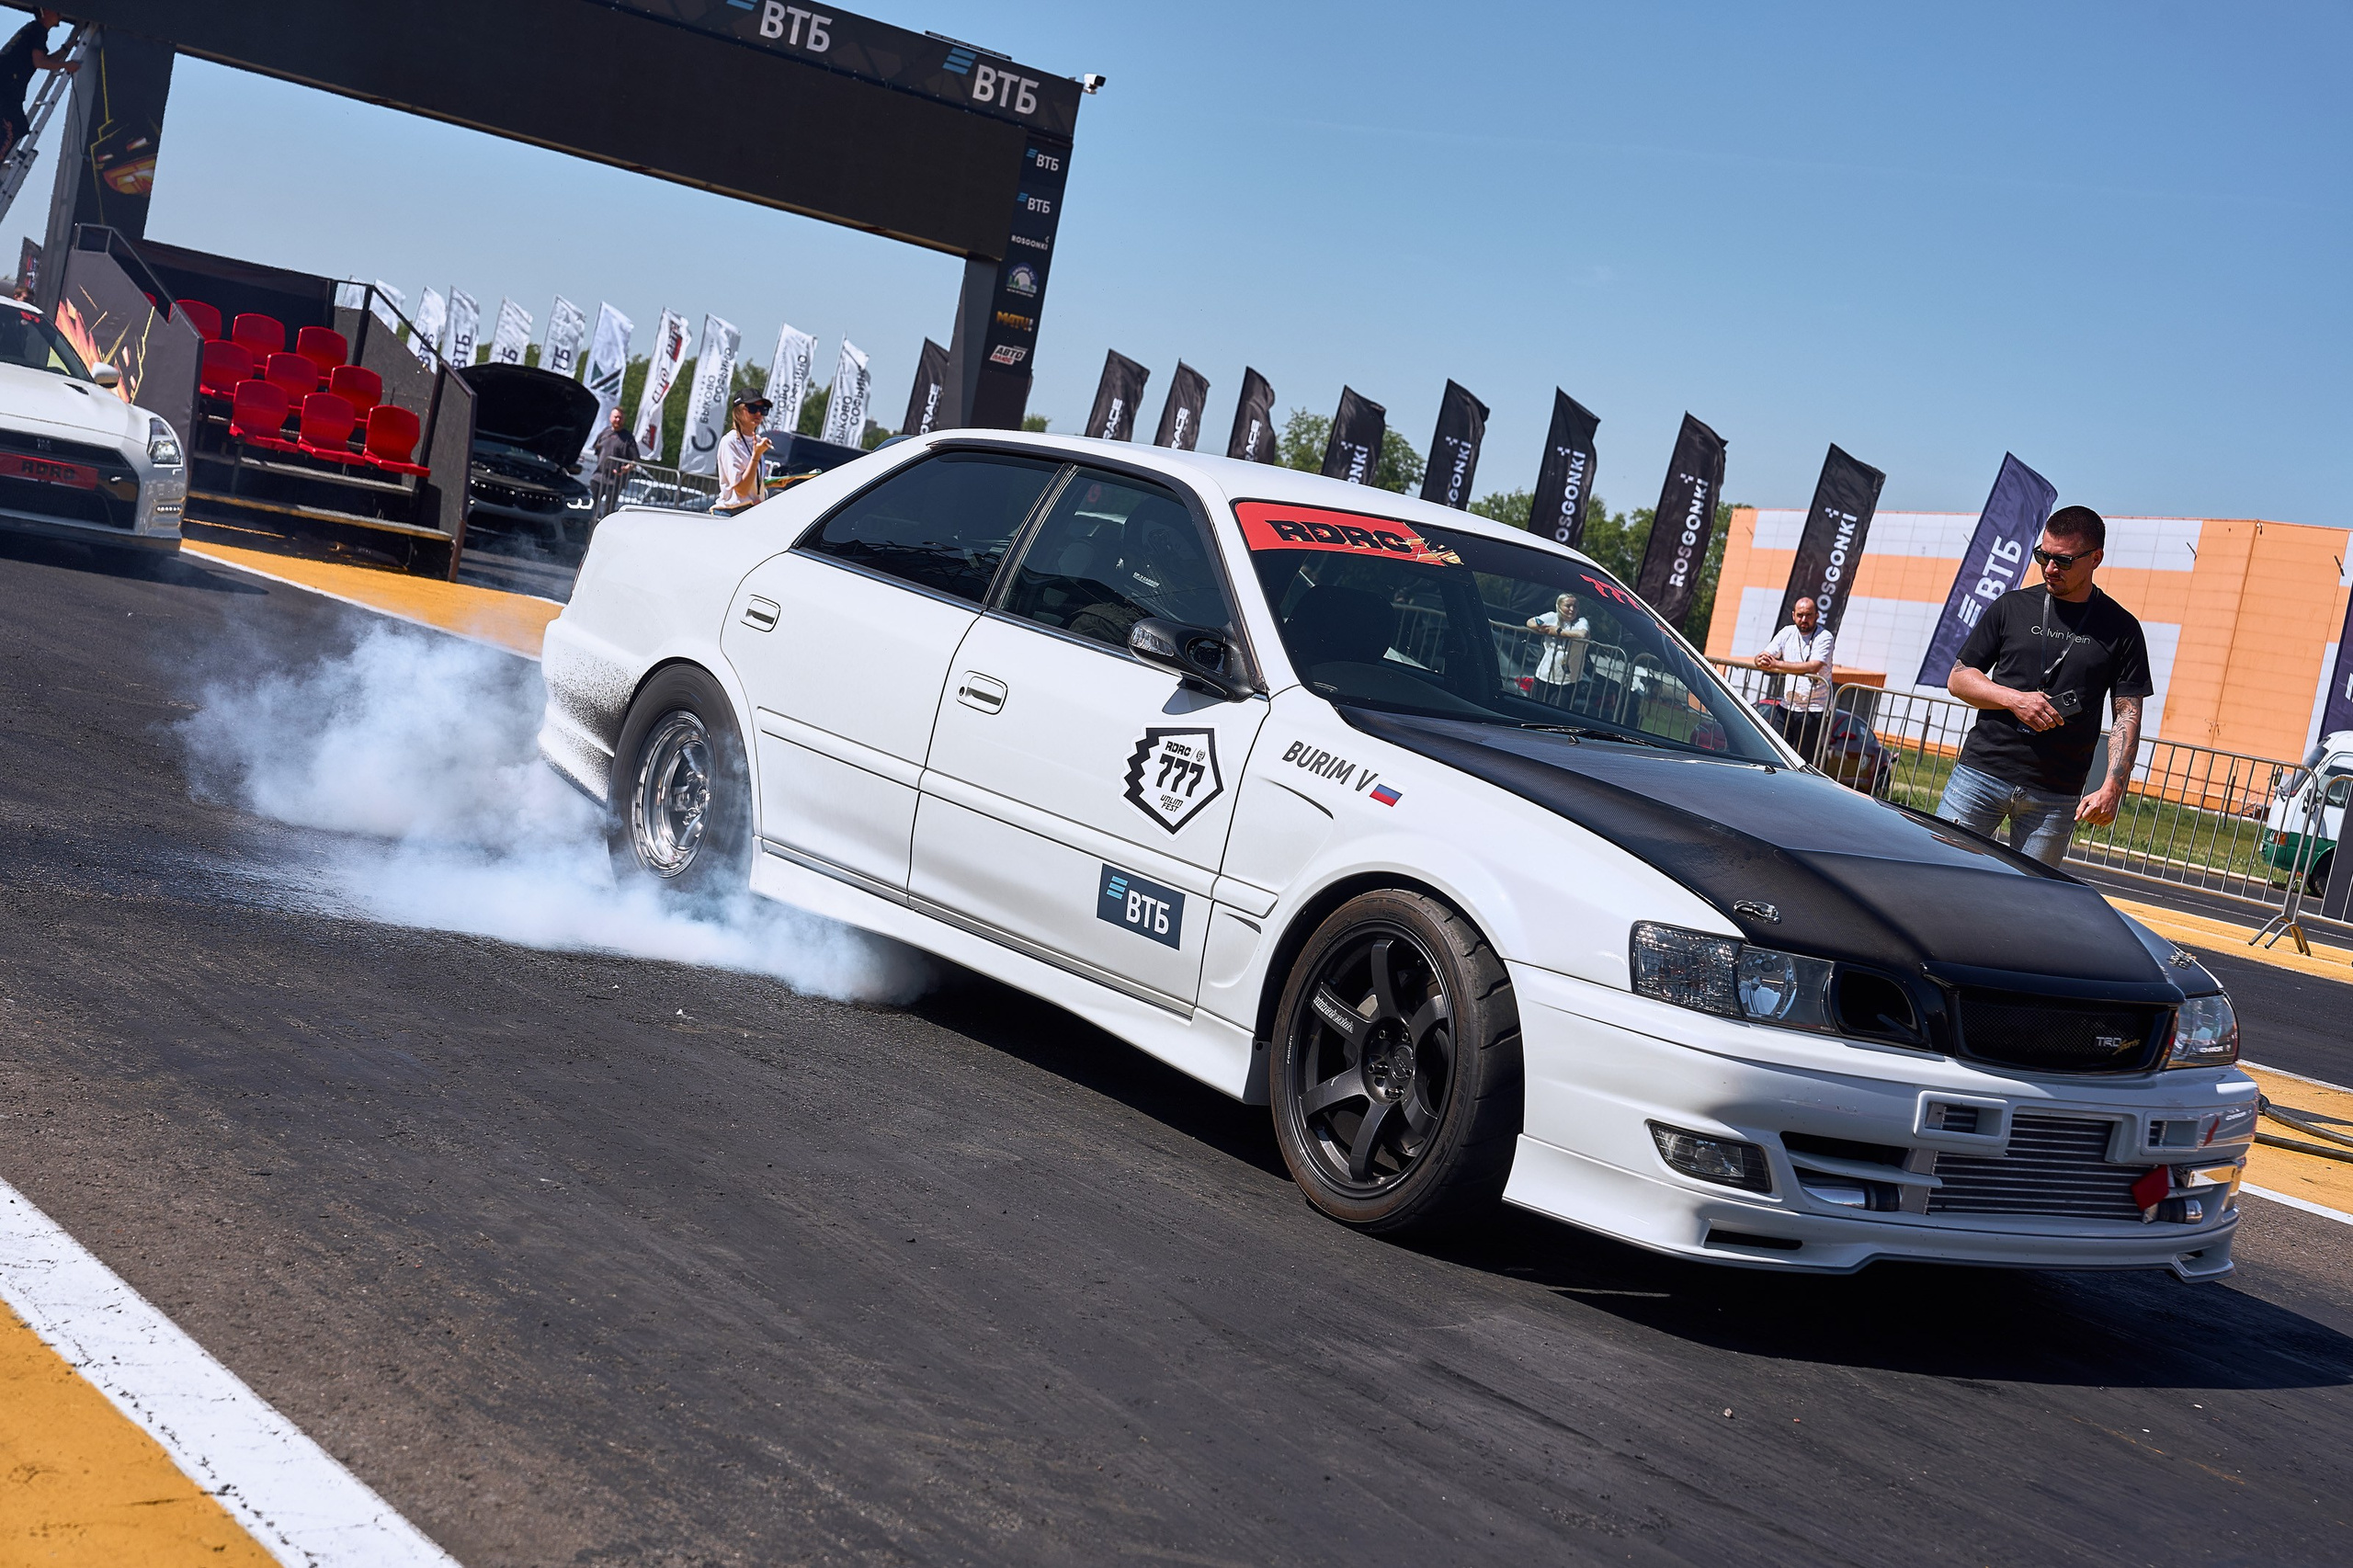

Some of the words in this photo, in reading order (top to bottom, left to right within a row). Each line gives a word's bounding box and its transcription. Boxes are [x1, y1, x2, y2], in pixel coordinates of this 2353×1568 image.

[759, 0, 833, 53] ВТБ
[972, 64, 1040, 116] ВТБ
[1036, 153, 1059, 171] ВТБ
[1028, 197, 1051, 214] ВТБ
[995, 347, 1024, 359] АВТО
[699, 375, 716, 424] БЫКОВО
[1265, 519, 1414, 553] RDRC
[1669, 477, 1710, 588] ROSGONKI
[1974, 534, 2023, 601] ВТБ
[1165, 740, 1192, 757] RDRC
[1281, 740, 1357, 786] BURIM
[1355, 768, 1380, 792] V
[1155, 753, 1206, 799] 777
[1161, 801, 1180, 813] FEST
[1126, 889, 1171, 935] ВТБ
[2096, 1036, 2122, 1048] TRD
